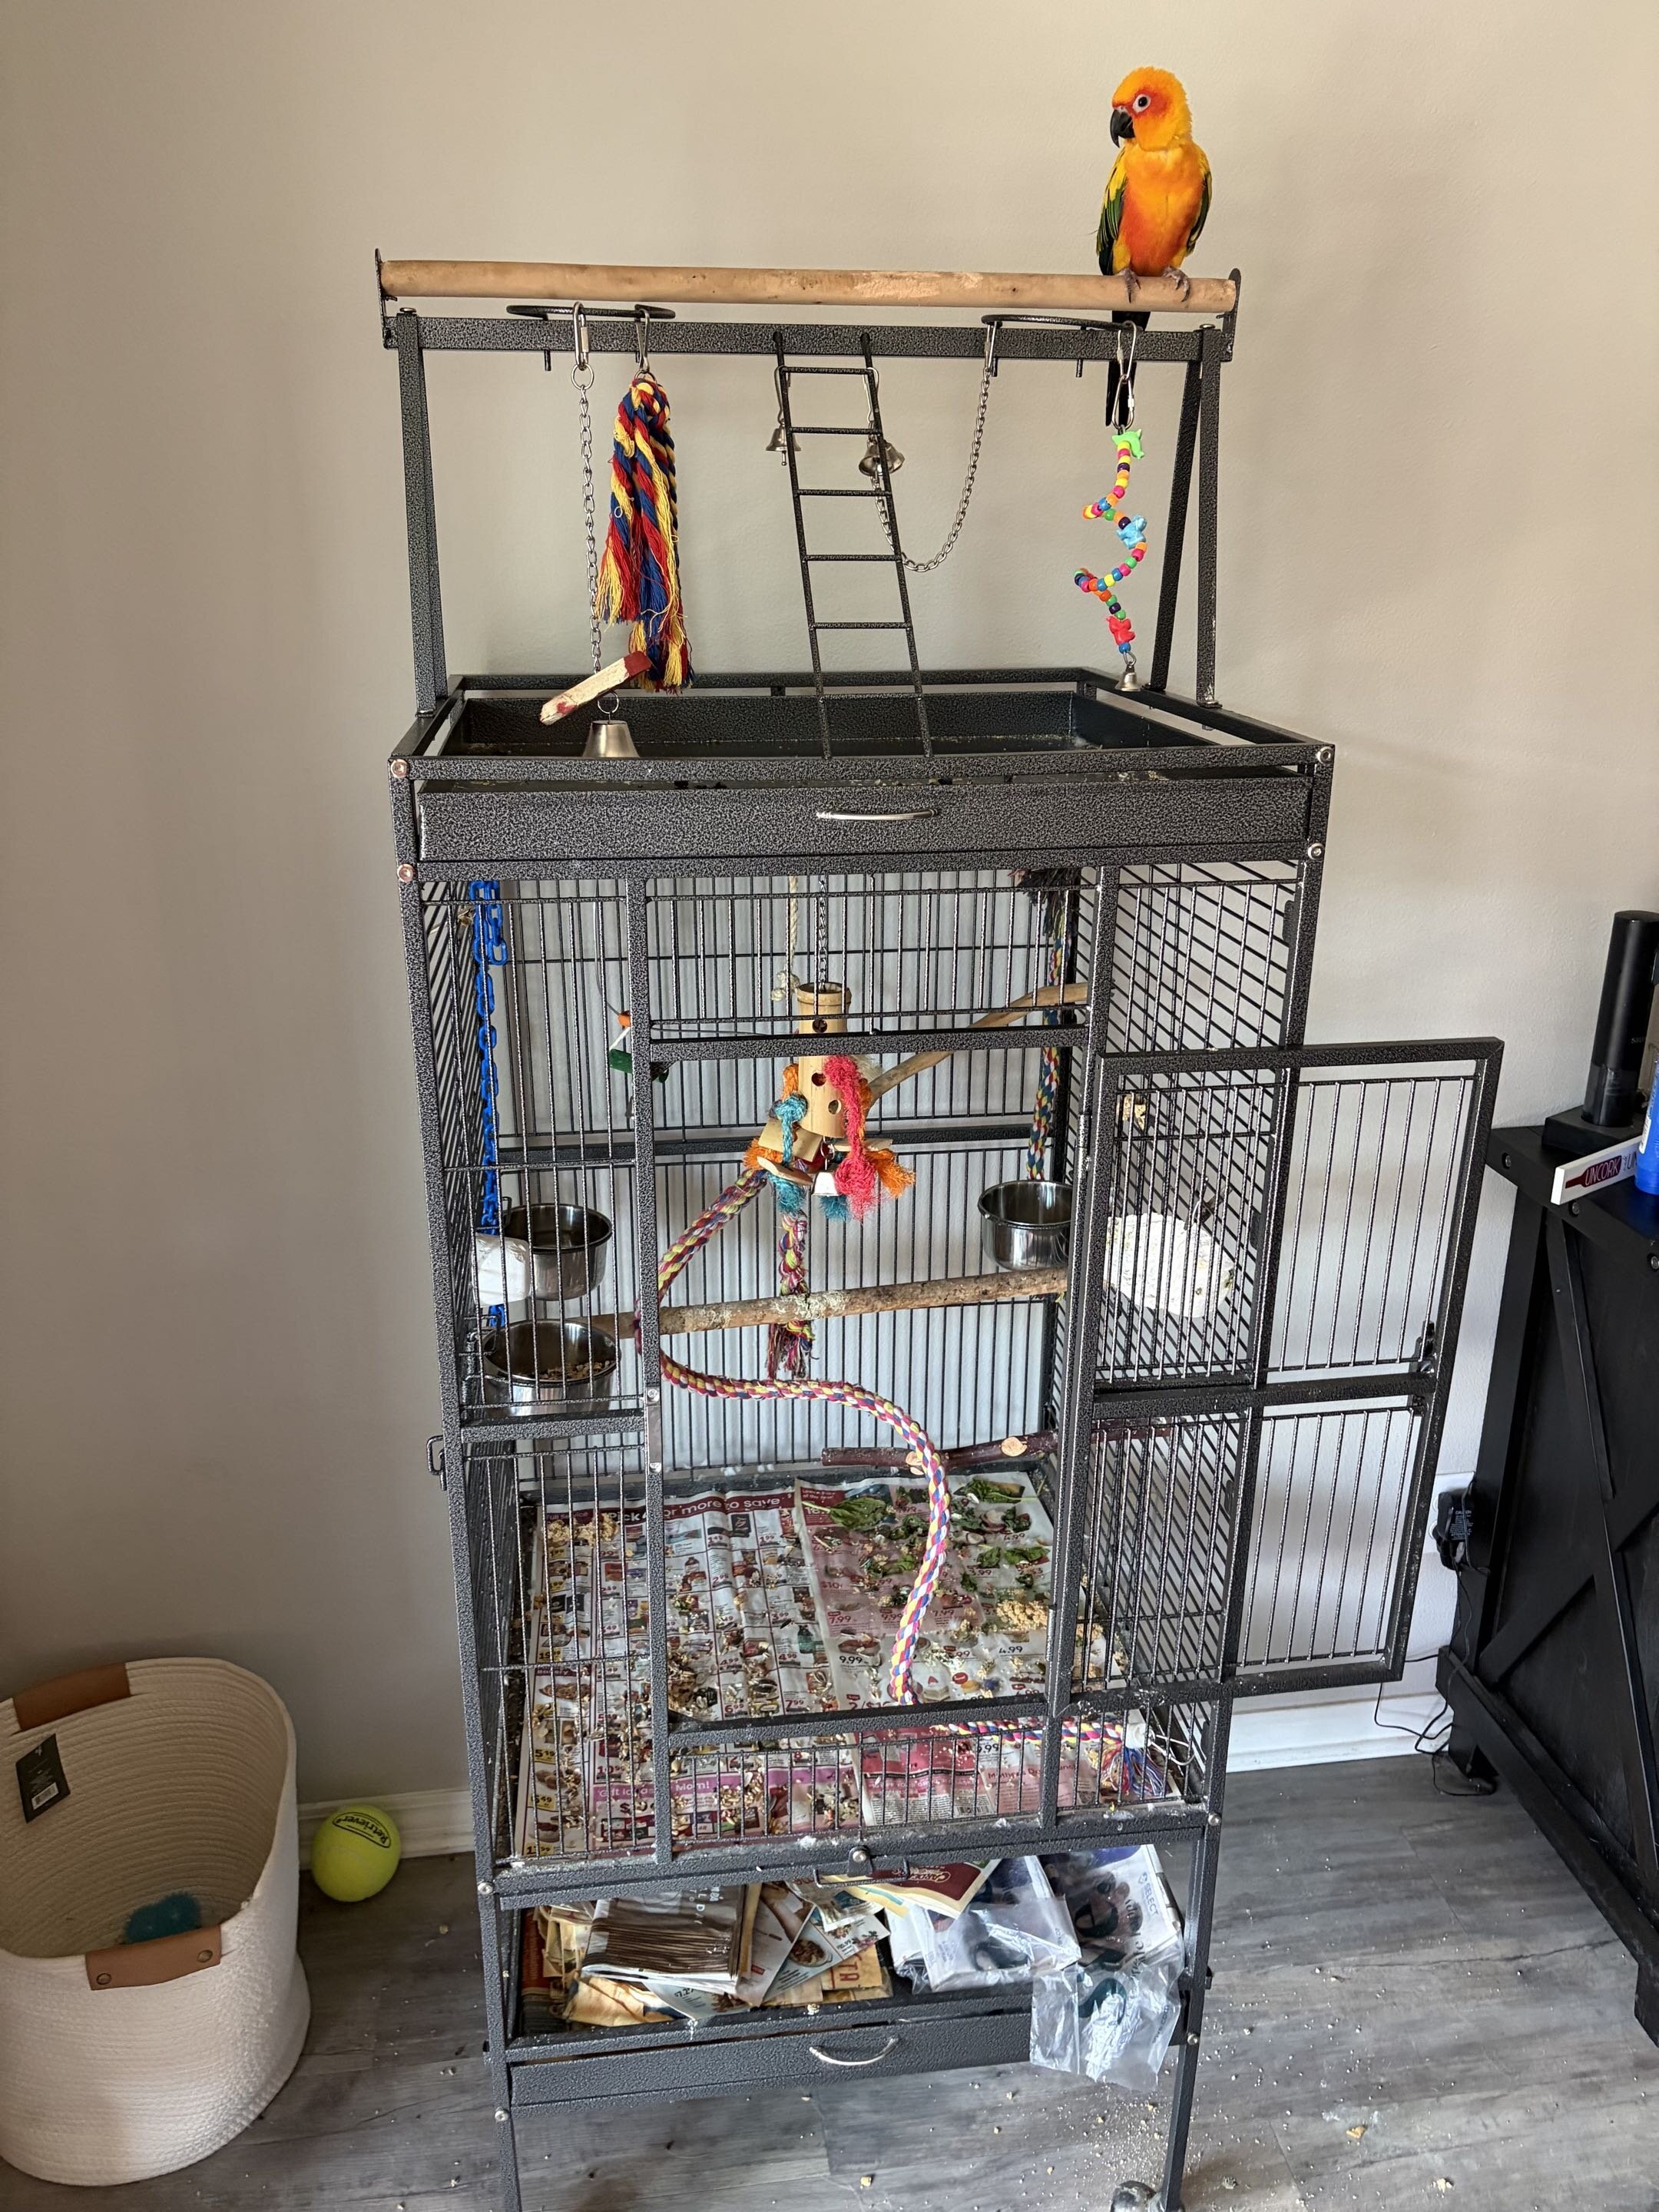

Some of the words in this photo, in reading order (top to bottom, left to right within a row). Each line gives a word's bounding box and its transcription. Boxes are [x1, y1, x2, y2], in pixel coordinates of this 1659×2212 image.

[1584, 1157, 1621, 1187] UNCORK
[609, 1512, 641, 1522] Pick
[680, 1501, 722, 1514] more
[743, 1498, 780, 1509] save
[829, 1615, 852, 1624] 7.99
[998, 1645, 1023, 1654] 4.99
[839, 1655, 863, 1665] 9.99
[599, 1788, 620, 1796] Gft
[342, 1816, 389, 1844] Retriever
[1144, 1883, 1158, 1915] SELECT
